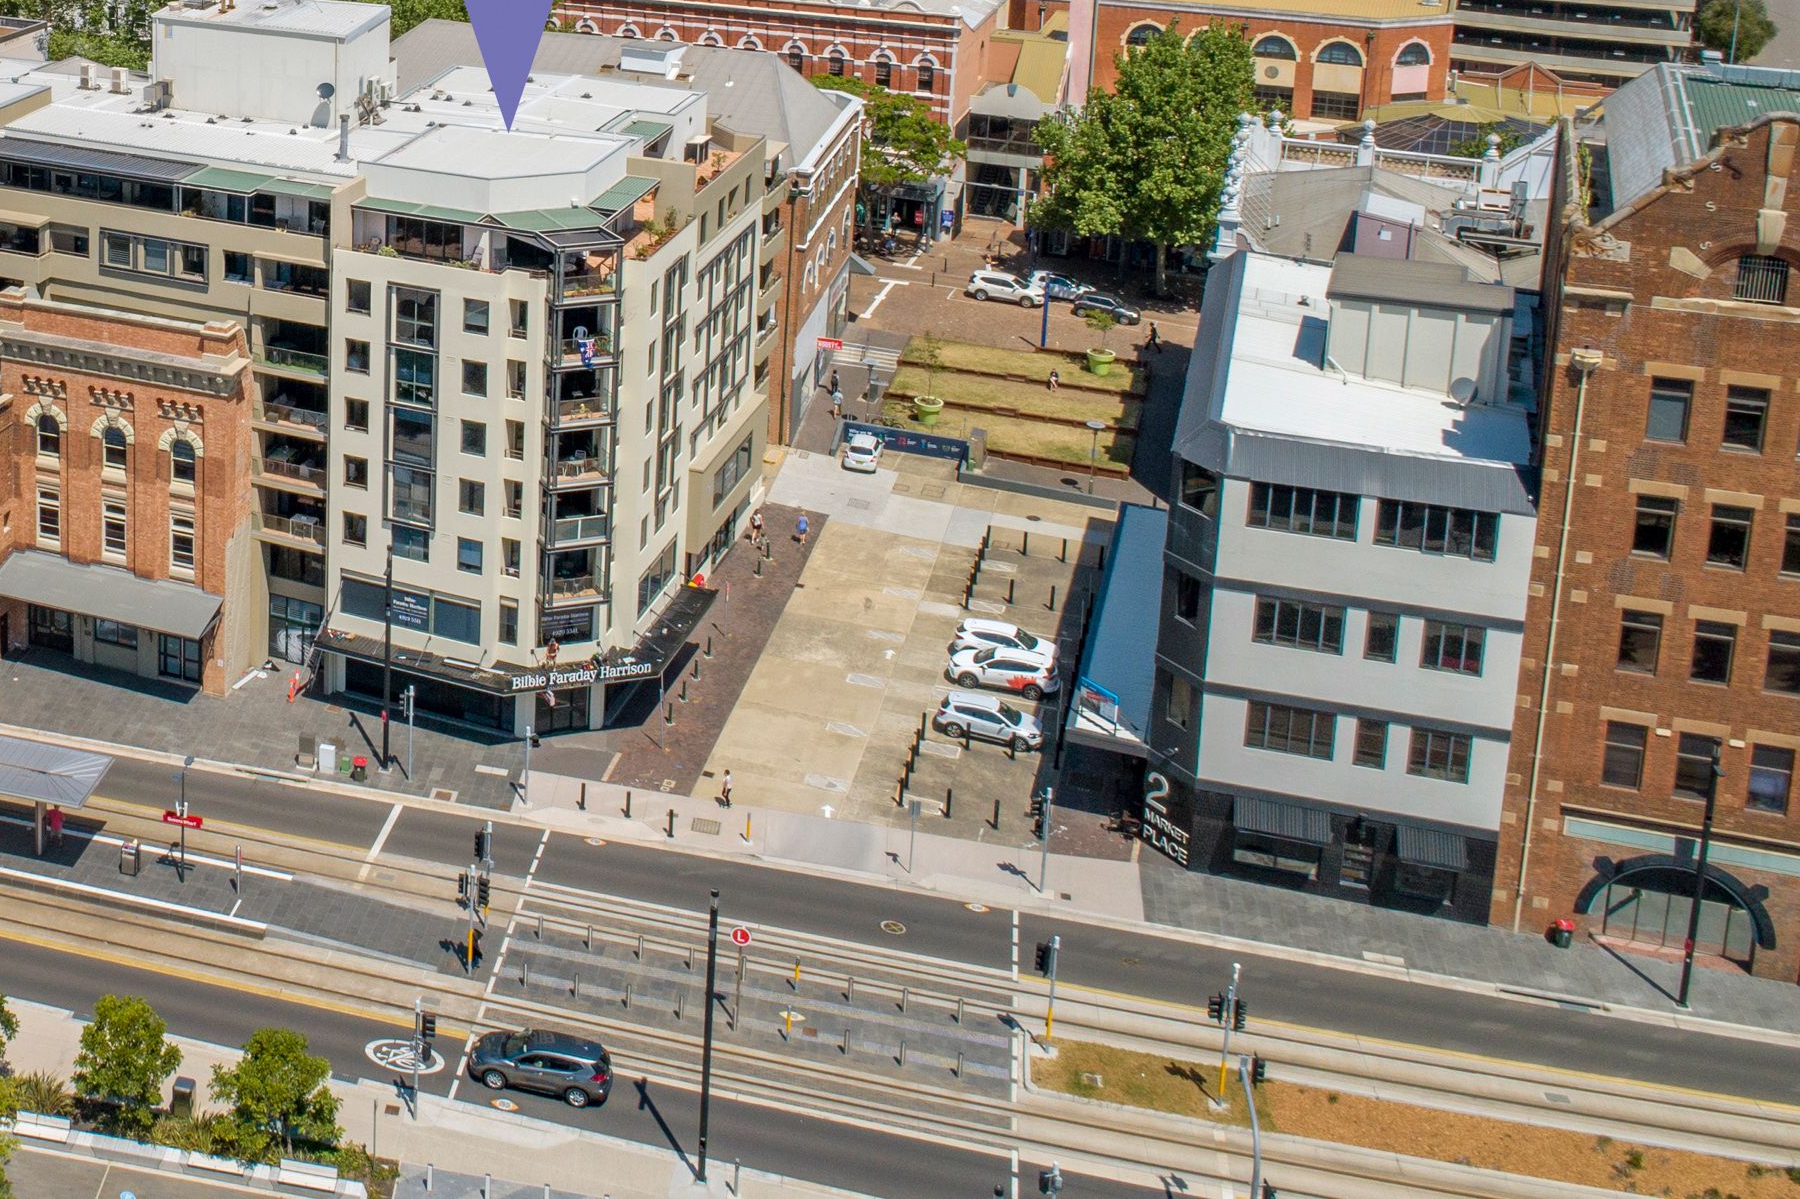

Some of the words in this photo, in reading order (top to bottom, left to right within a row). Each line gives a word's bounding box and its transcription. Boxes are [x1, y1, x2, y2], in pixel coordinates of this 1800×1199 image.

[512, 674, 547, 690] Bilbie
[549, 669, 598, 685] Faraday
[600, 663, 652, 679] Harrison
[1145, 772, 1169, 814] 2
[1143, 823, 1188, 865] PLACE
[1144, 807, 1190, 844] MARKET
[737, 930, 745, 943] L
